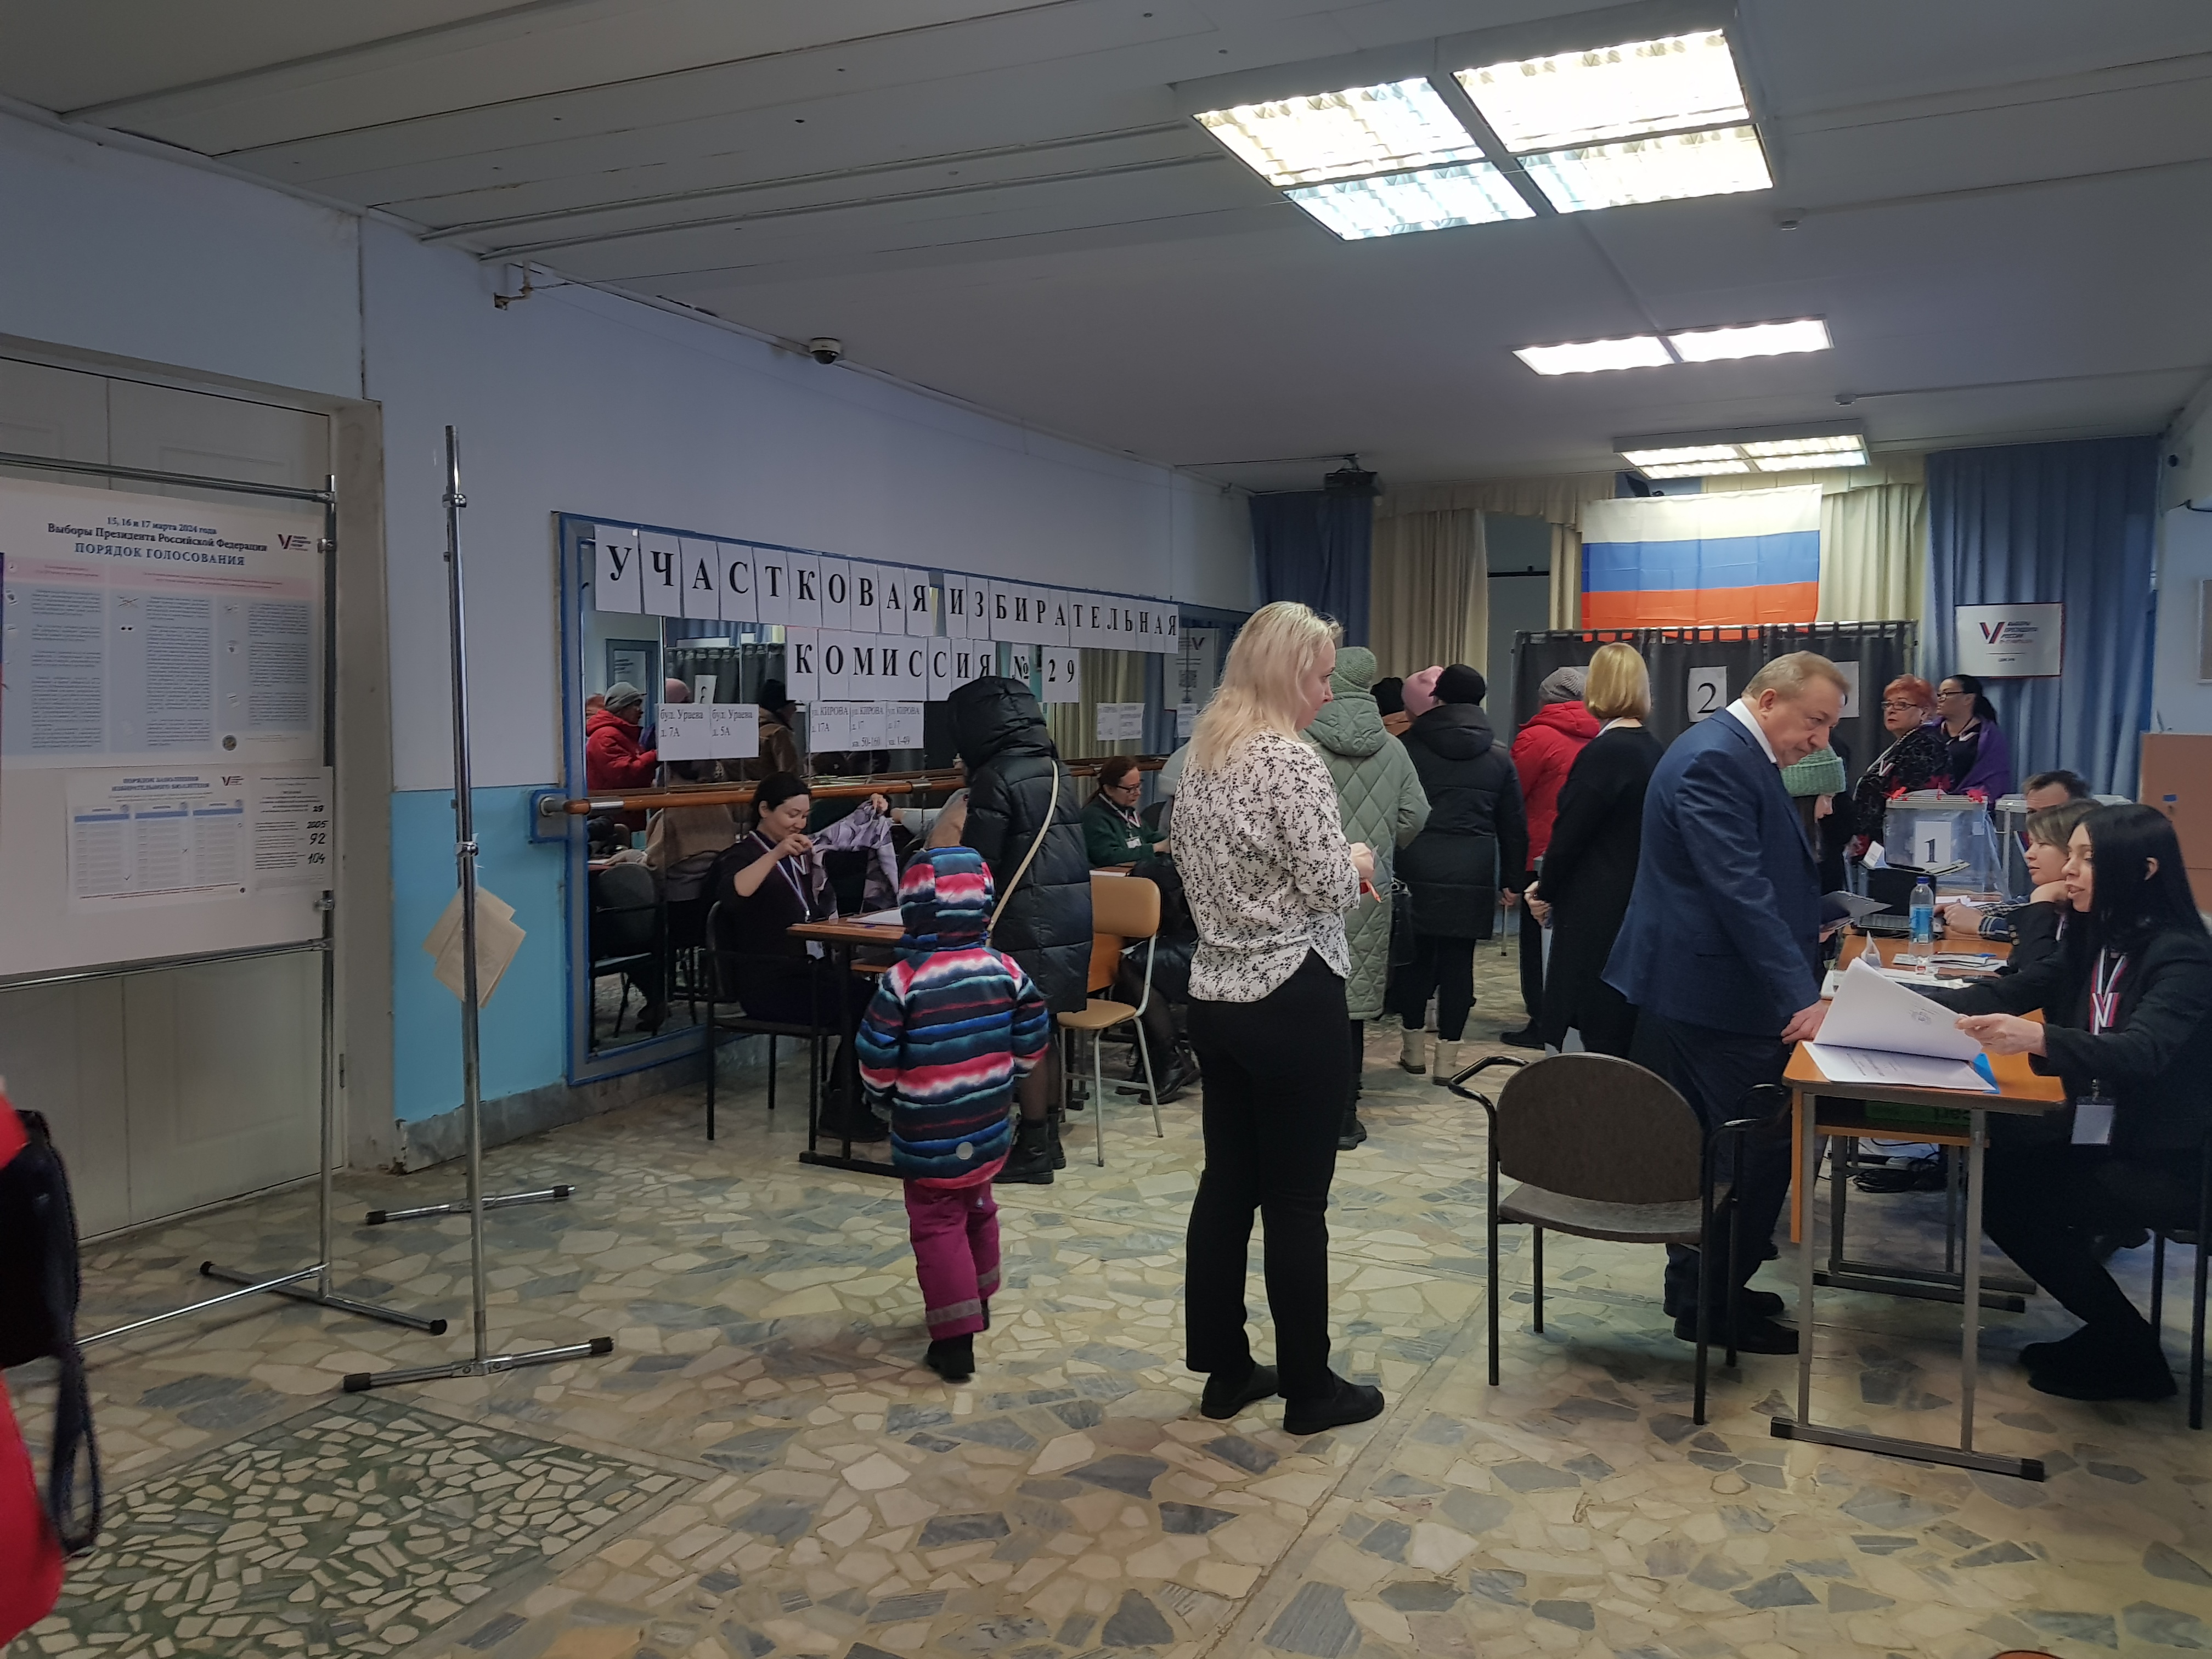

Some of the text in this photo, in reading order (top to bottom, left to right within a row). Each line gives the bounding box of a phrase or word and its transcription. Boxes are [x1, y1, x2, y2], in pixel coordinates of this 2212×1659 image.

[47, 523, 268, 552] Выборы Президента Российской Федерации
[142, 520, 151, 528] 17
[179, 524, 198, 533] 2024
[75, 542, 245, 566] ПОРЯДОК ГОЛОСОВАНИЯ
[606, 545, 928, 613] УЧАСТКОВАЯ
[949, 588, 1177, 636] ИЗБИРАТЕЛЬНАЯ
[794, 644, 1075, 683] КОМИССИЯ № 29
[1697, 682, 1716, 714] 2
[669, 727, 680, 737] 7А
[720, 726, 731, 736] 5А
[1923, 838, 1939, 863] 1
